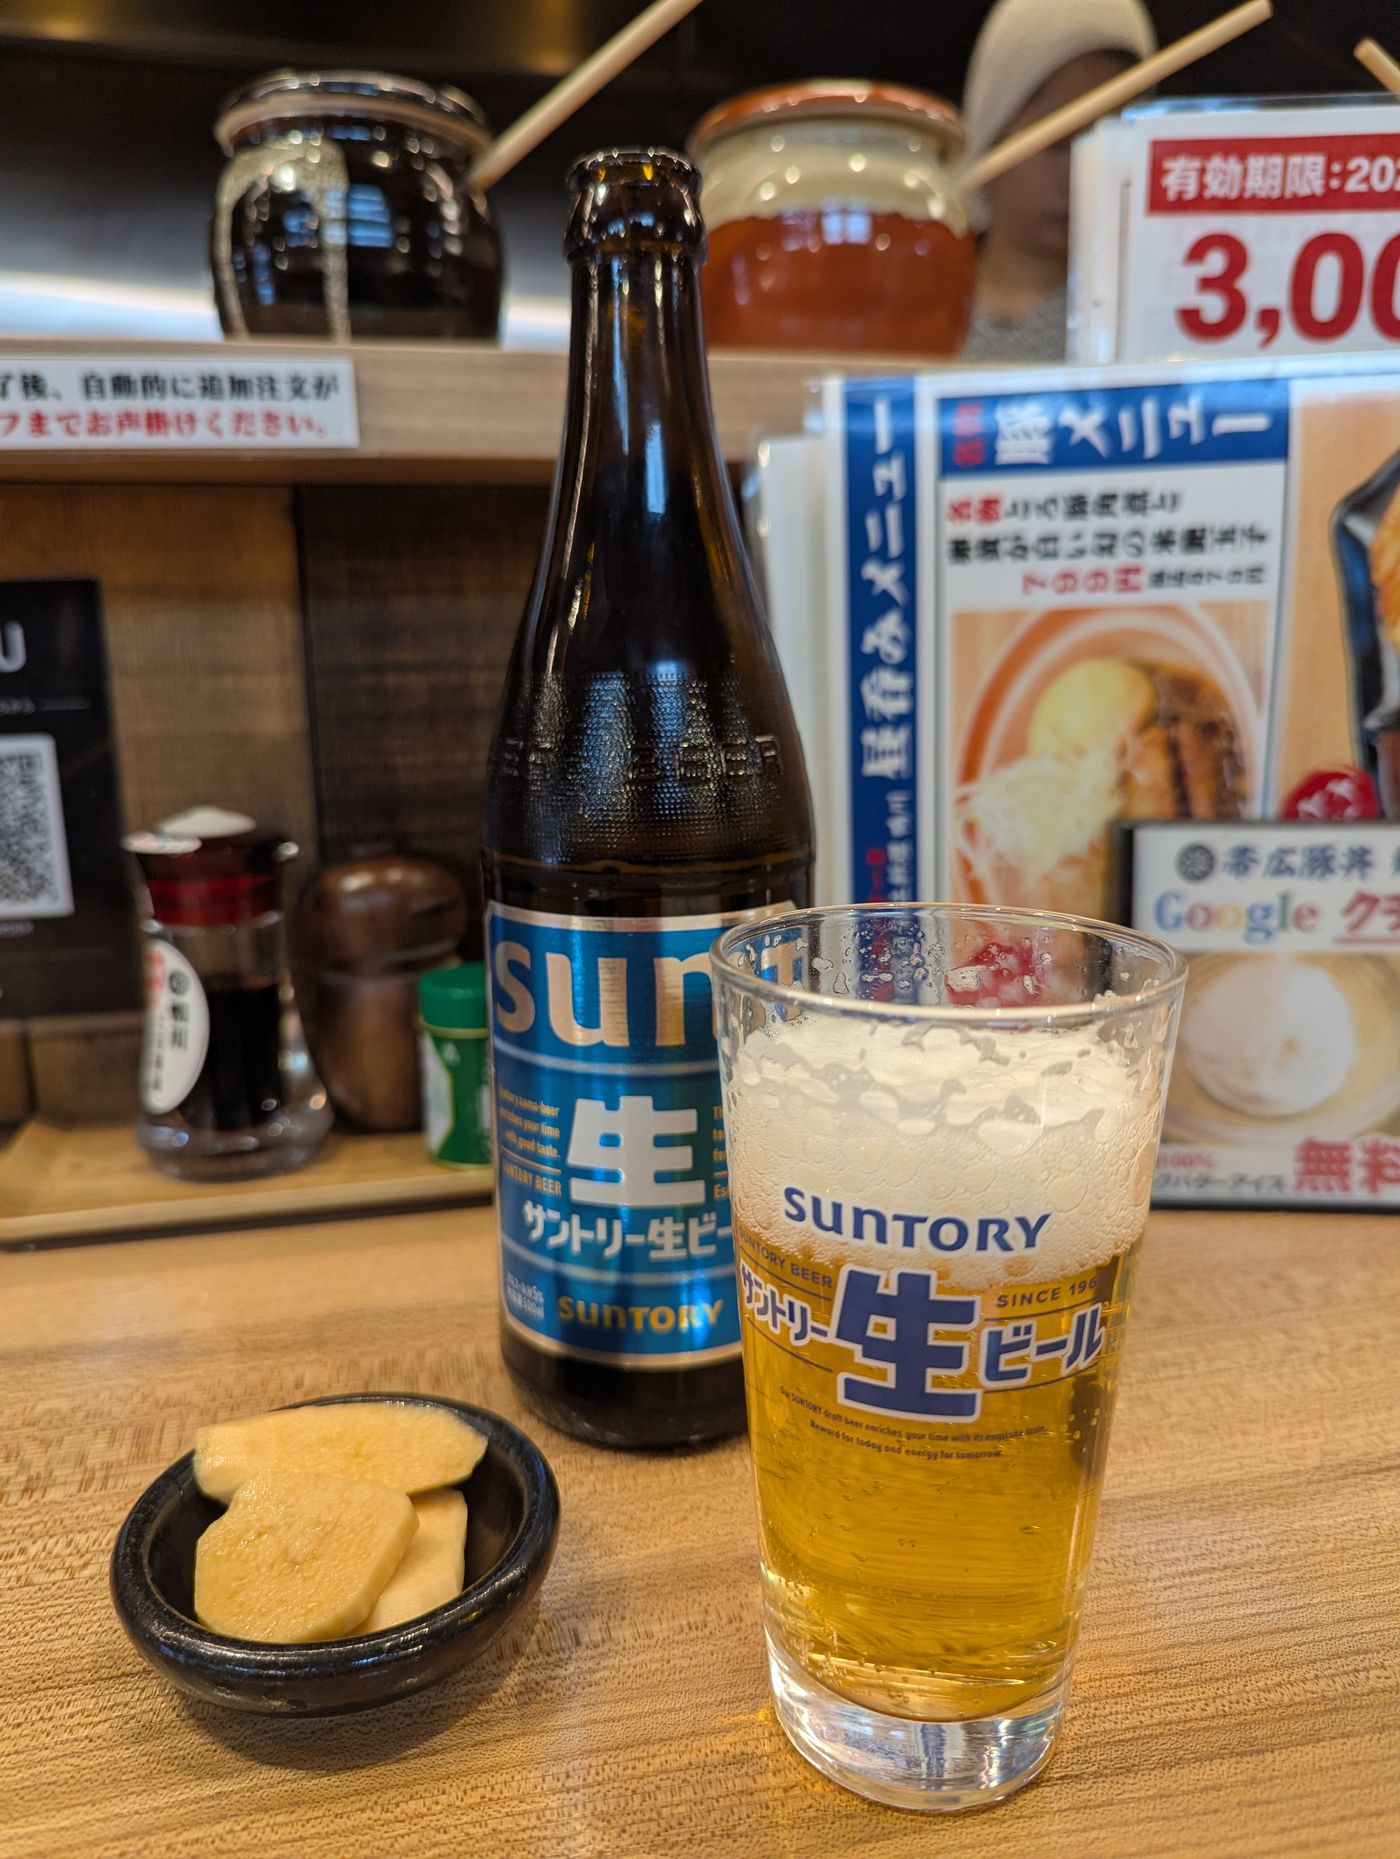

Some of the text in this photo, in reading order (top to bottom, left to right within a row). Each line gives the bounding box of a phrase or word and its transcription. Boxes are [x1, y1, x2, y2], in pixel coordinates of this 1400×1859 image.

[1161, 154, 1400, 200] 有効期限:20
[1154, 891, 1320, 944] Google
[566, 1095, 706, 1206] 生
[535, 1174, 562, 1197] BEER
[784, 1186, 1053, 1252] SUNTORY
[790, 1263, 833, 1288] BEER
[996, 1276, 1098, 1308] SINCE 196
[558, 1296, 724, 1332] SUNTORY
